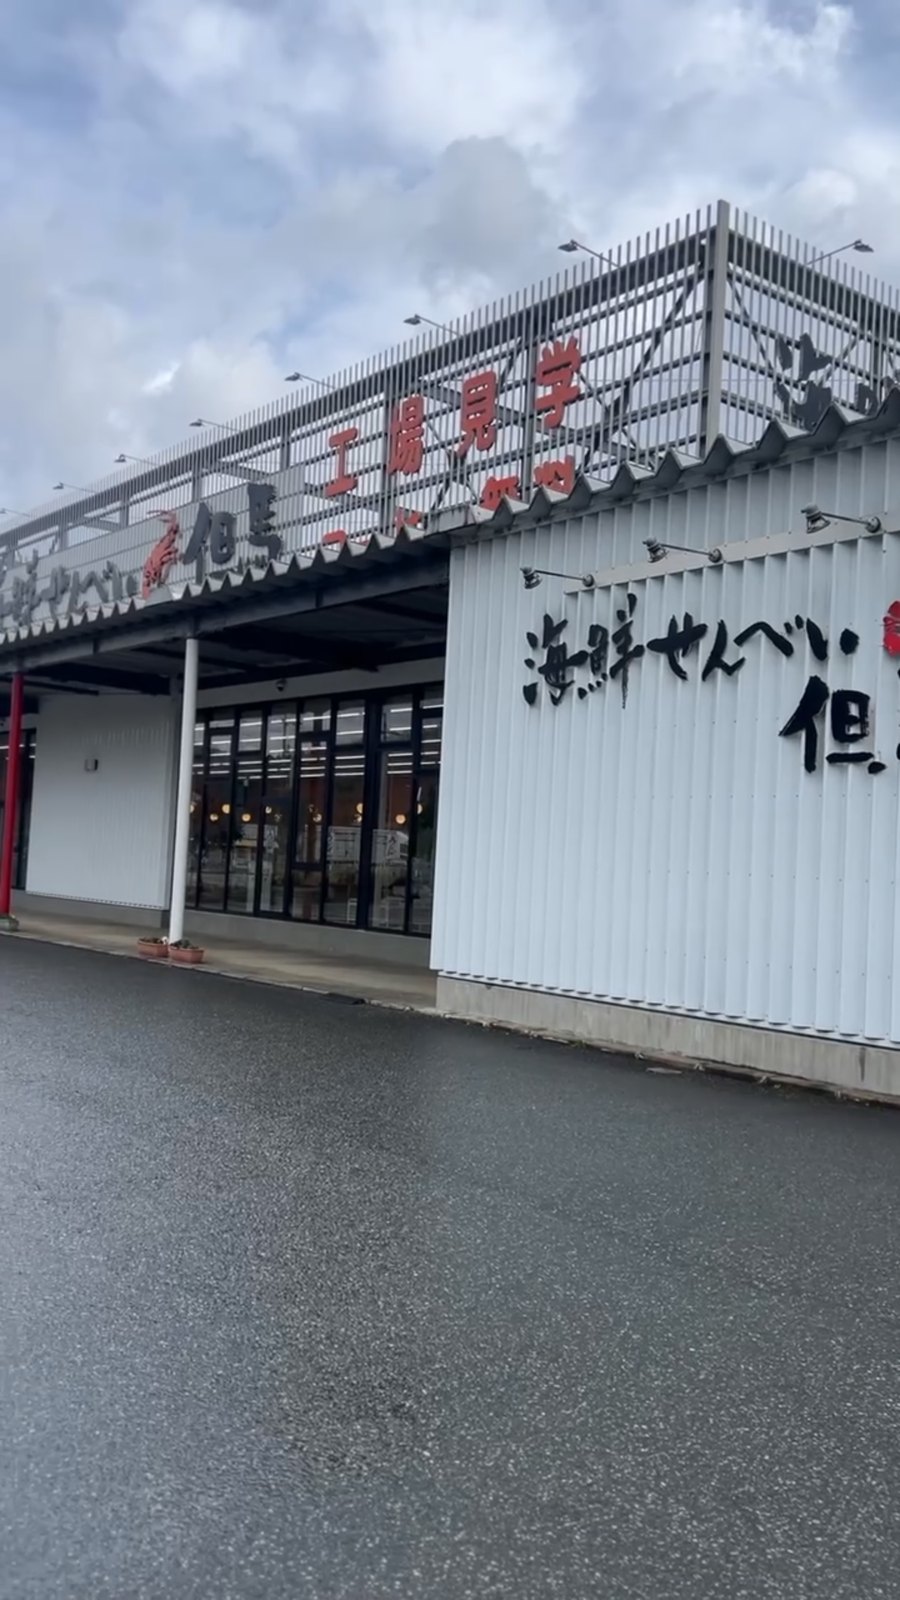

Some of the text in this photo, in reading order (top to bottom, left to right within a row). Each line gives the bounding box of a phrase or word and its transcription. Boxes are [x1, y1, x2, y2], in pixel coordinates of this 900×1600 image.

[325, 336, 582, 498] 工場見学
[523, 593, 860, 708] 海鮮せんべい
[779, 675, 900, 774] 但
